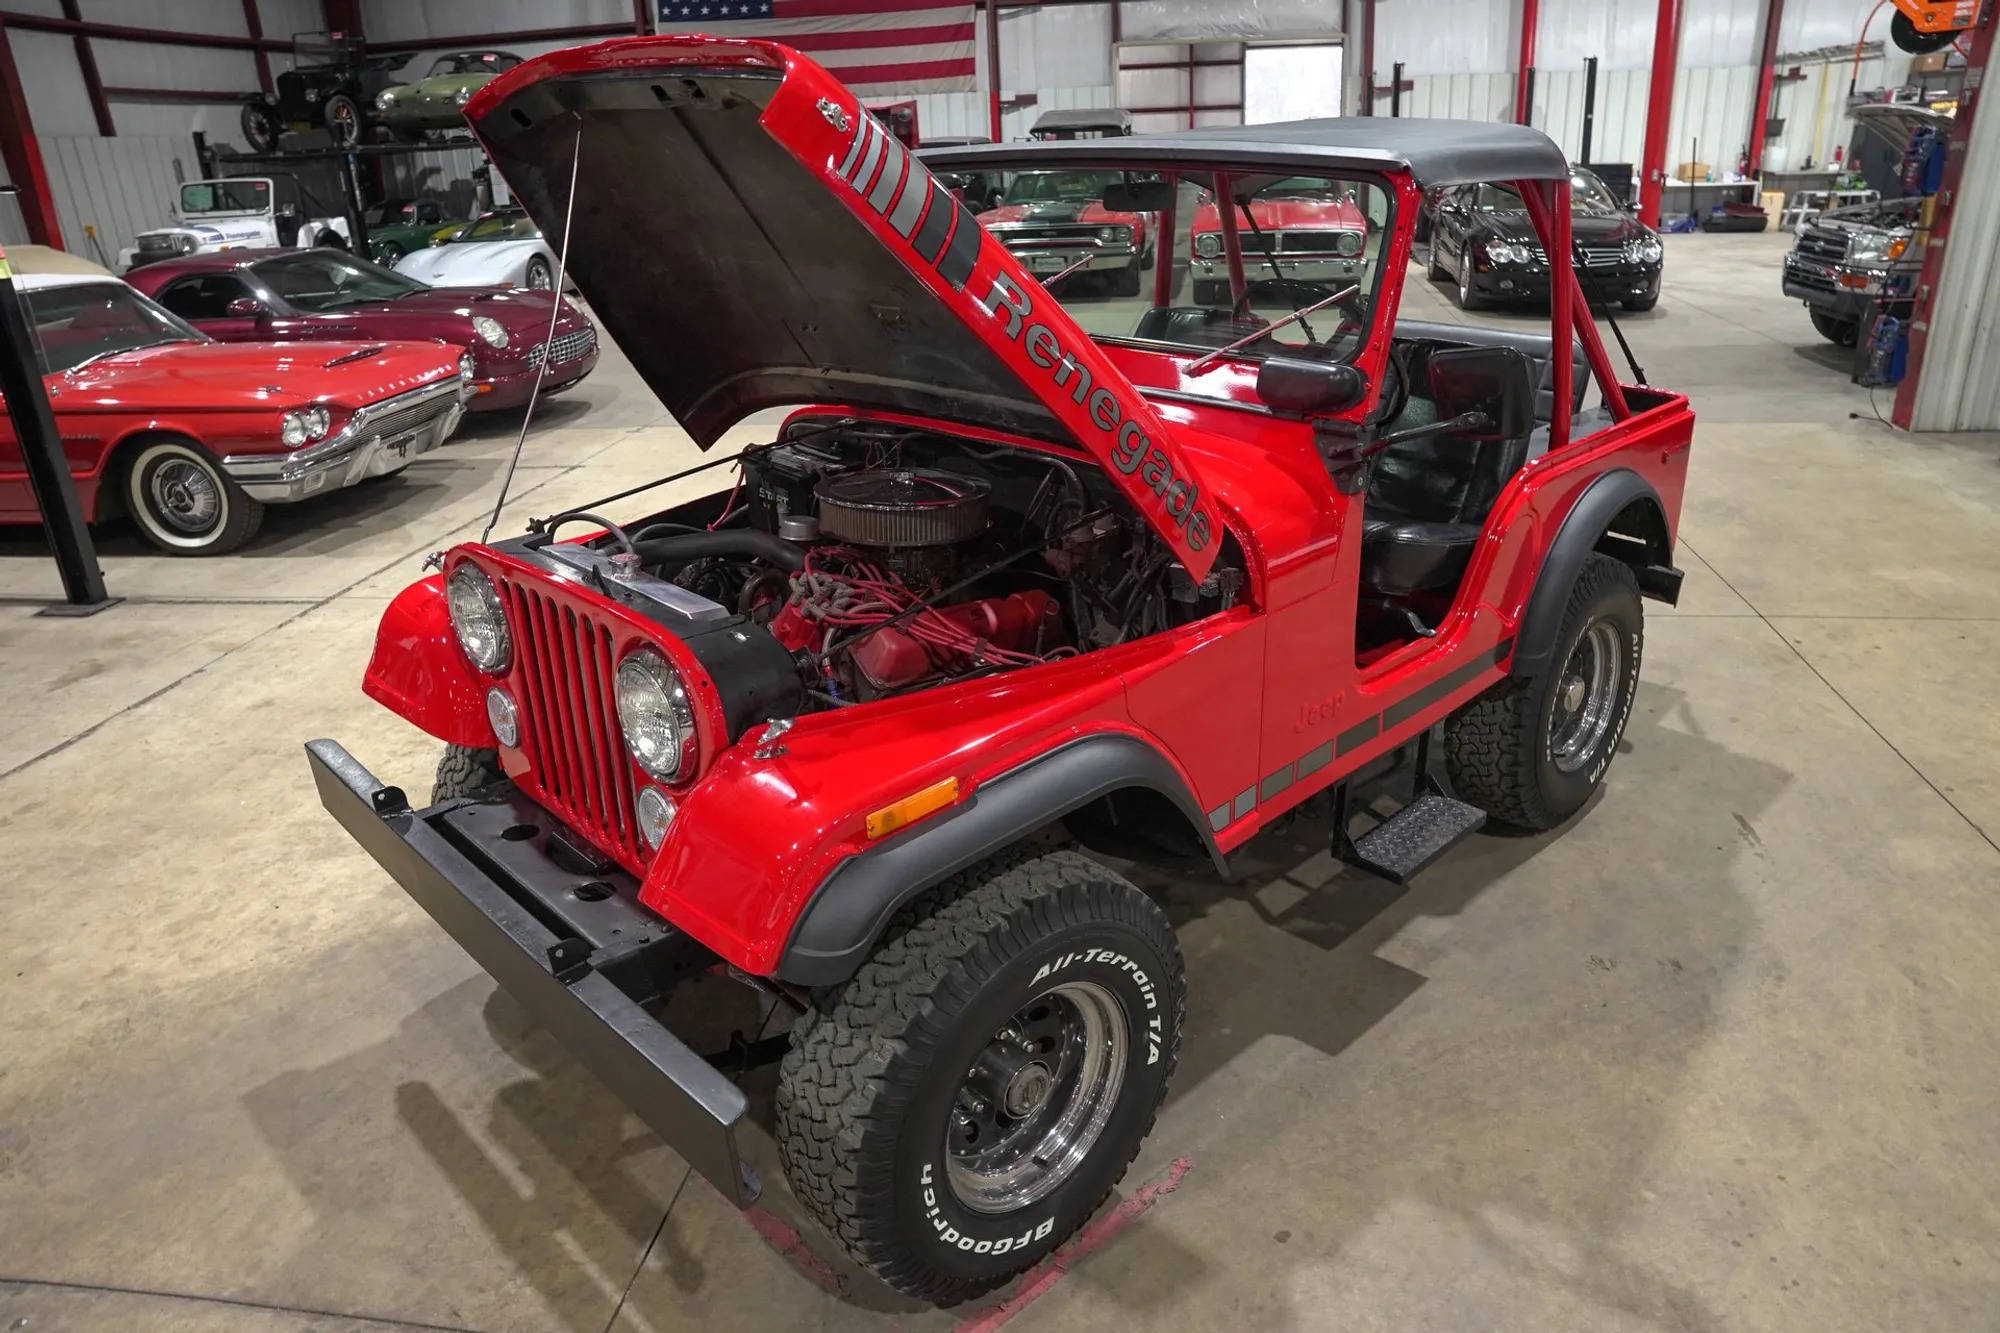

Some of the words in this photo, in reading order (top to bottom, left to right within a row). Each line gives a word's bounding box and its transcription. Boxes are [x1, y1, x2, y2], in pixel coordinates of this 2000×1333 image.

[984, 270, 1210, 551] Renegade
[1293, 688, 1345, 734] Jeep
[1608, 633, 1639, 754] All-Terrain
[1589, 757, 1607, 785] T/A
[1028, 948, 1157, 1010] All-Terrain
[1146, 1014, 1162, 1066] T/A
[920, 1163, 1055, 1256] BFGoodrich
